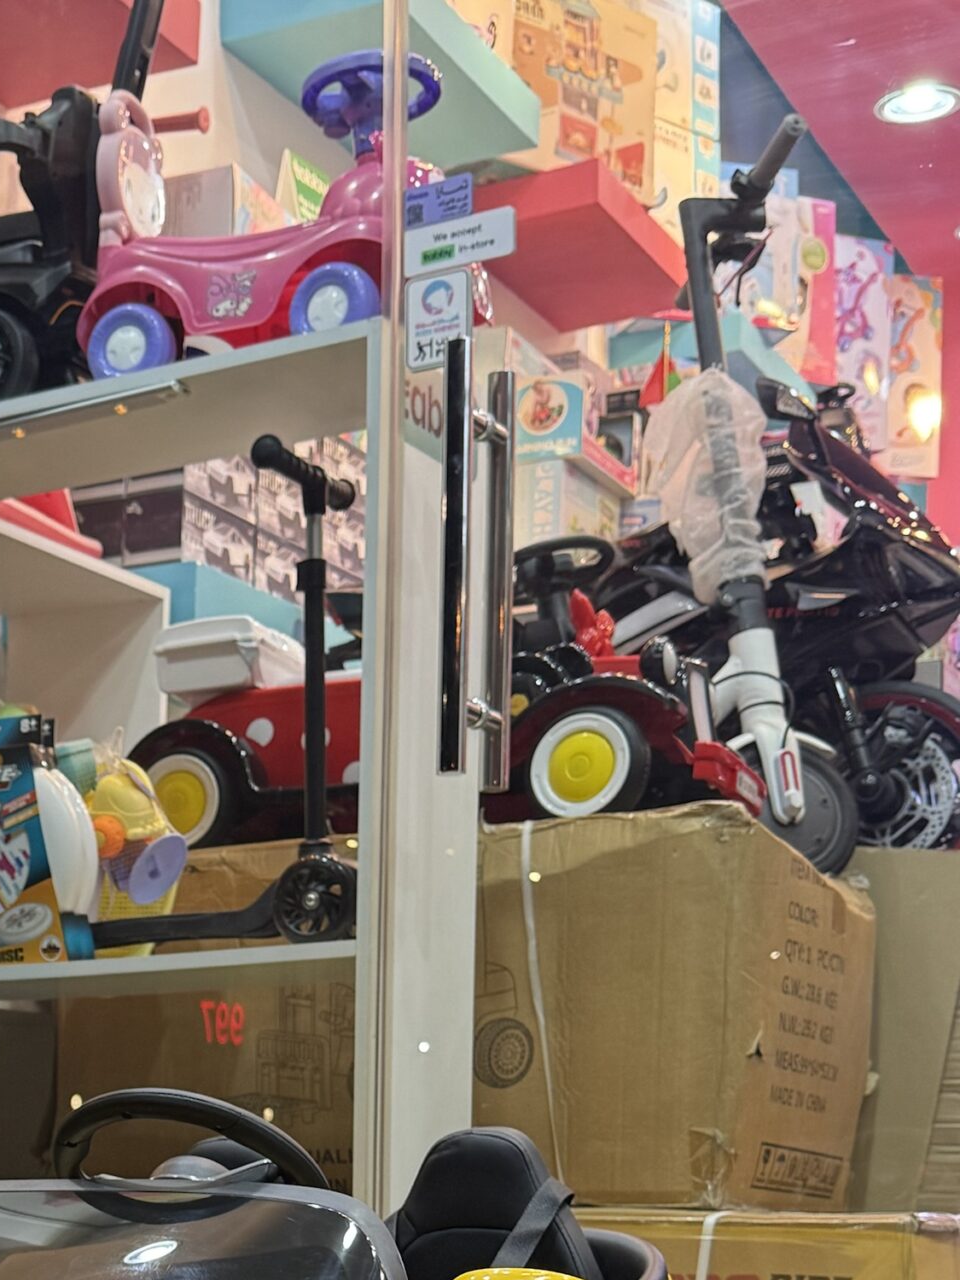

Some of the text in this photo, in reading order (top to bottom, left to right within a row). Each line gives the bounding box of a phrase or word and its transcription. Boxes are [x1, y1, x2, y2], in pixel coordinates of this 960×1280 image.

[433, 224, 482, 242] We accept
[459, 239, 495, 253] in-store
[19, 717, 38, 733] 8+
